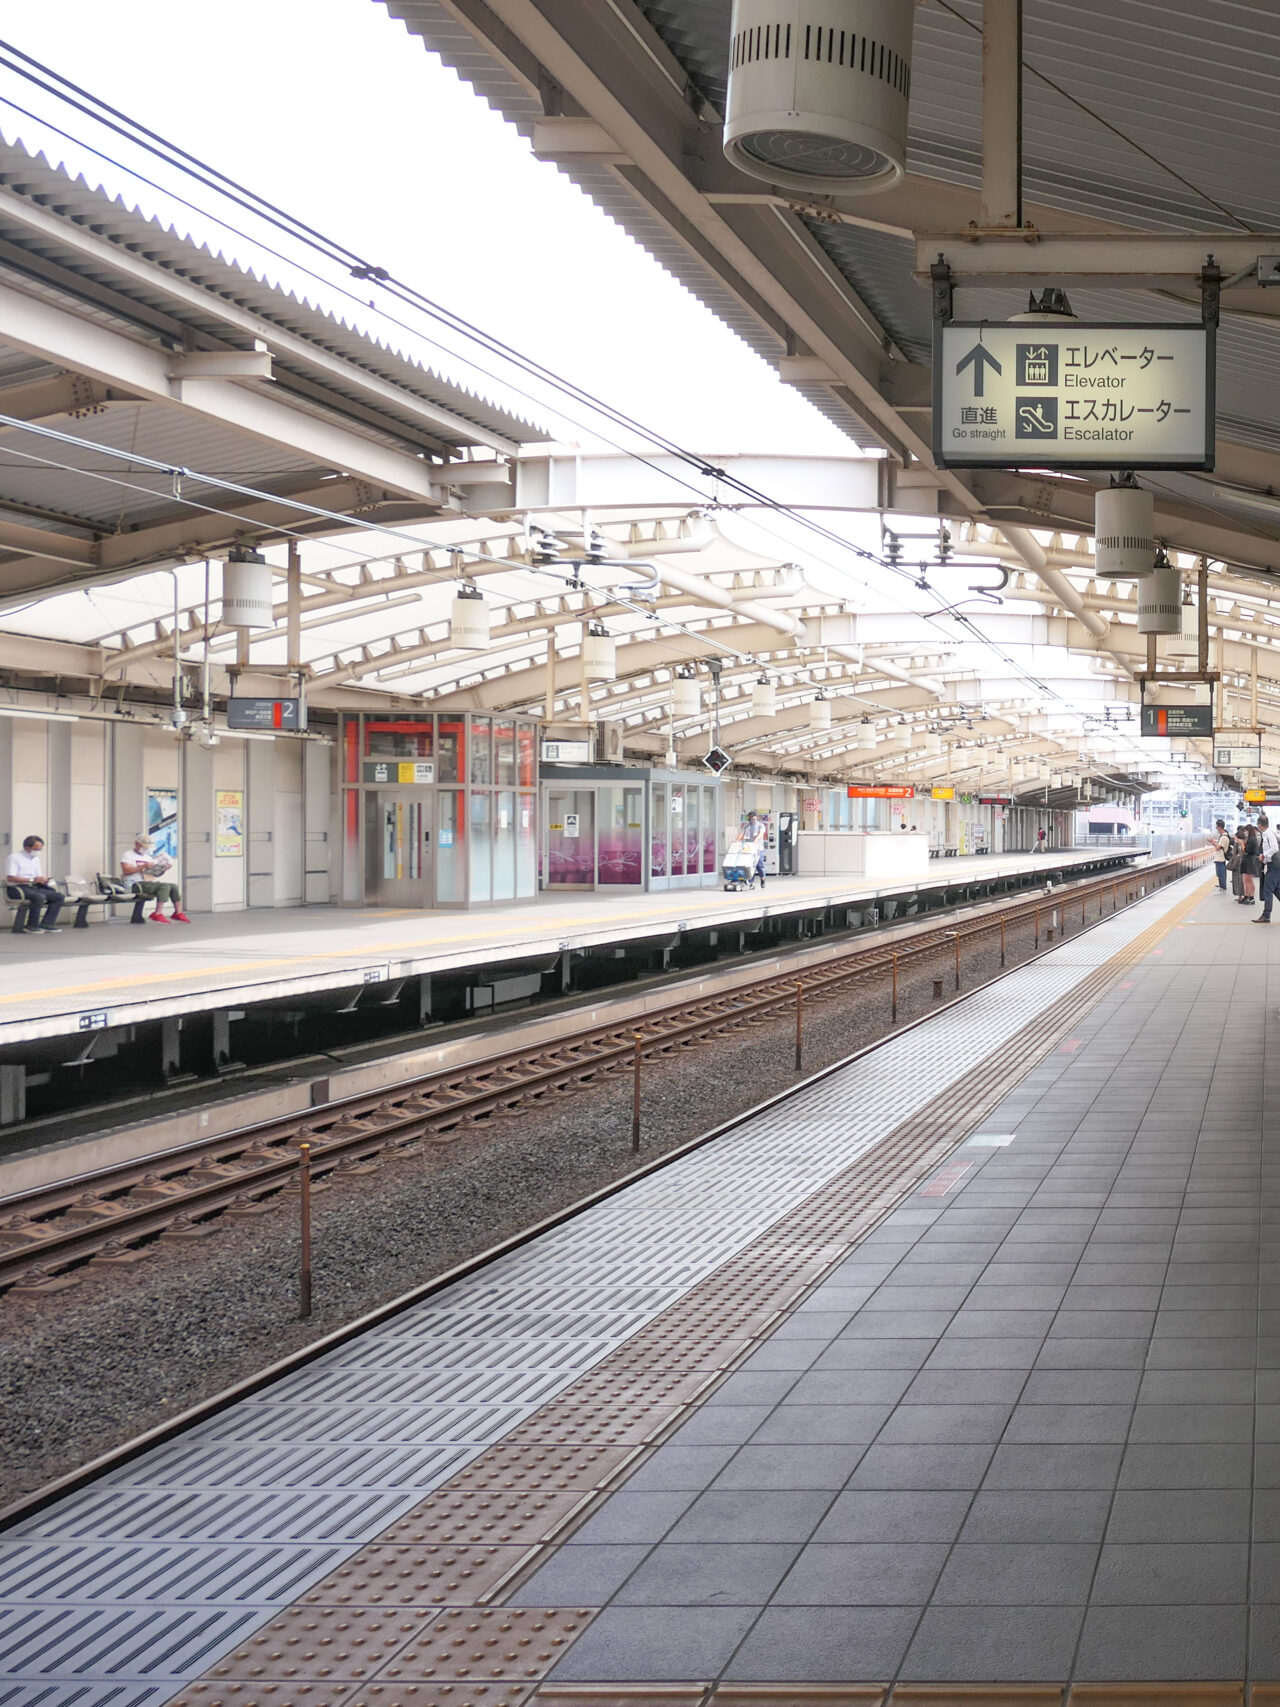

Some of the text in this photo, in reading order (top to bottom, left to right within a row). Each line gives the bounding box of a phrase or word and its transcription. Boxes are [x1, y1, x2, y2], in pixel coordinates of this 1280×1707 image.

[1064, 346, 1174, 369] エレベーター
[1064, 374, 1126, 388] Elevator
[961, 407, 998, 425] 直進
[1064, 399, 1191, 422] エスカレーター
[952, 428, 1006, 441] Go straight
[1064, 427, 1134, 441] Escalator
[283, 702, 294, 718] 2
[1147, 710, 1154, 725] 1
[905, 788, 911, 797] 2
